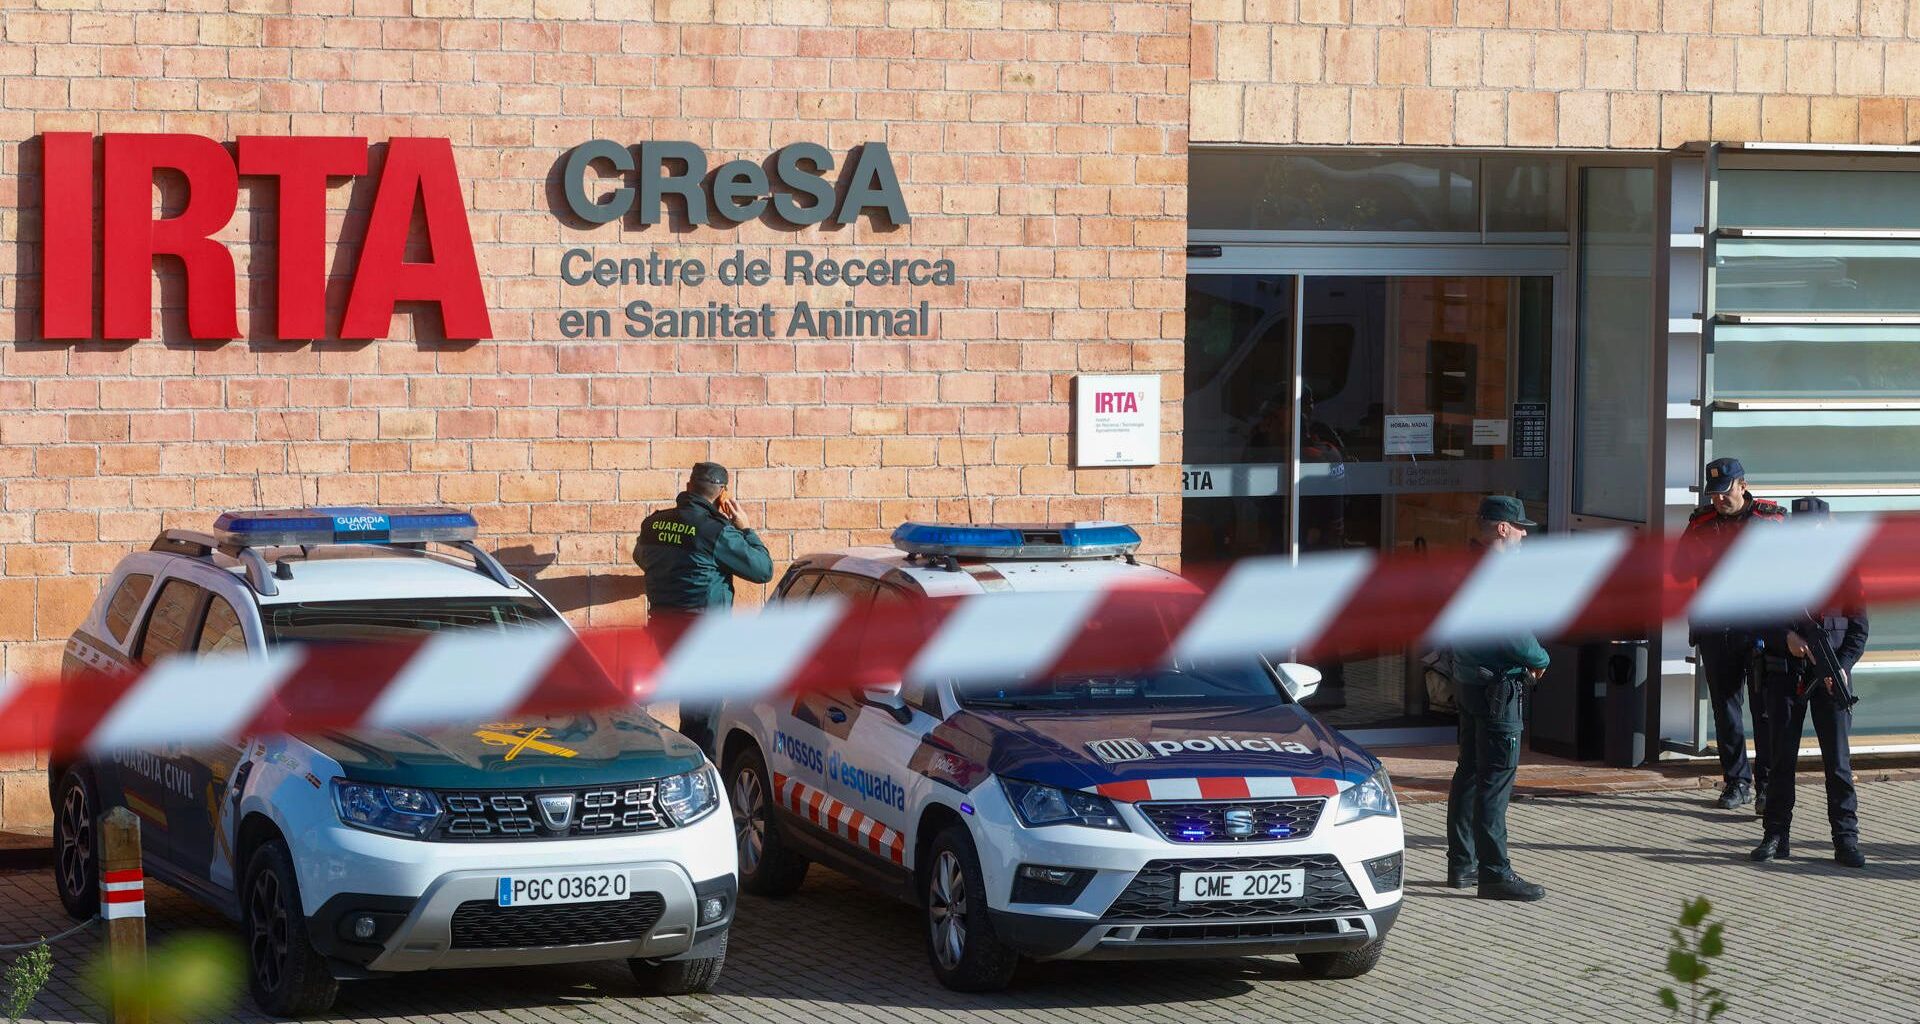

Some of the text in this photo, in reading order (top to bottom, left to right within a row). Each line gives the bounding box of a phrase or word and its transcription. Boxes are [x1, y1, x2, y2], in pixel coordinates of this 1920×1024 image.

[564, 139, 911, 225] CReSA
[42, 131, 493, 339] IRTA
[560, 248, 956, 286] Centre de Recerca
[559, 300, 930, 338] en Sanitat Animal
[1095, 392, 1138, 413] IRTA
[337, 516, 385, 525] GUARDIA
[349, 523, 377, 531] CIVIL
[652, 520, 696, 537] GUARDIA
[658, 532, 682, 545] CIVIL
[1149, 736, 1314, 756] policia
[164, 763, 194, 800] CIVIL
[772, 730, 905, 812] mossos d'esquadra
[514, 879, 553, 901] PGC
[1195, 874, 1292, 897] CME 2025
